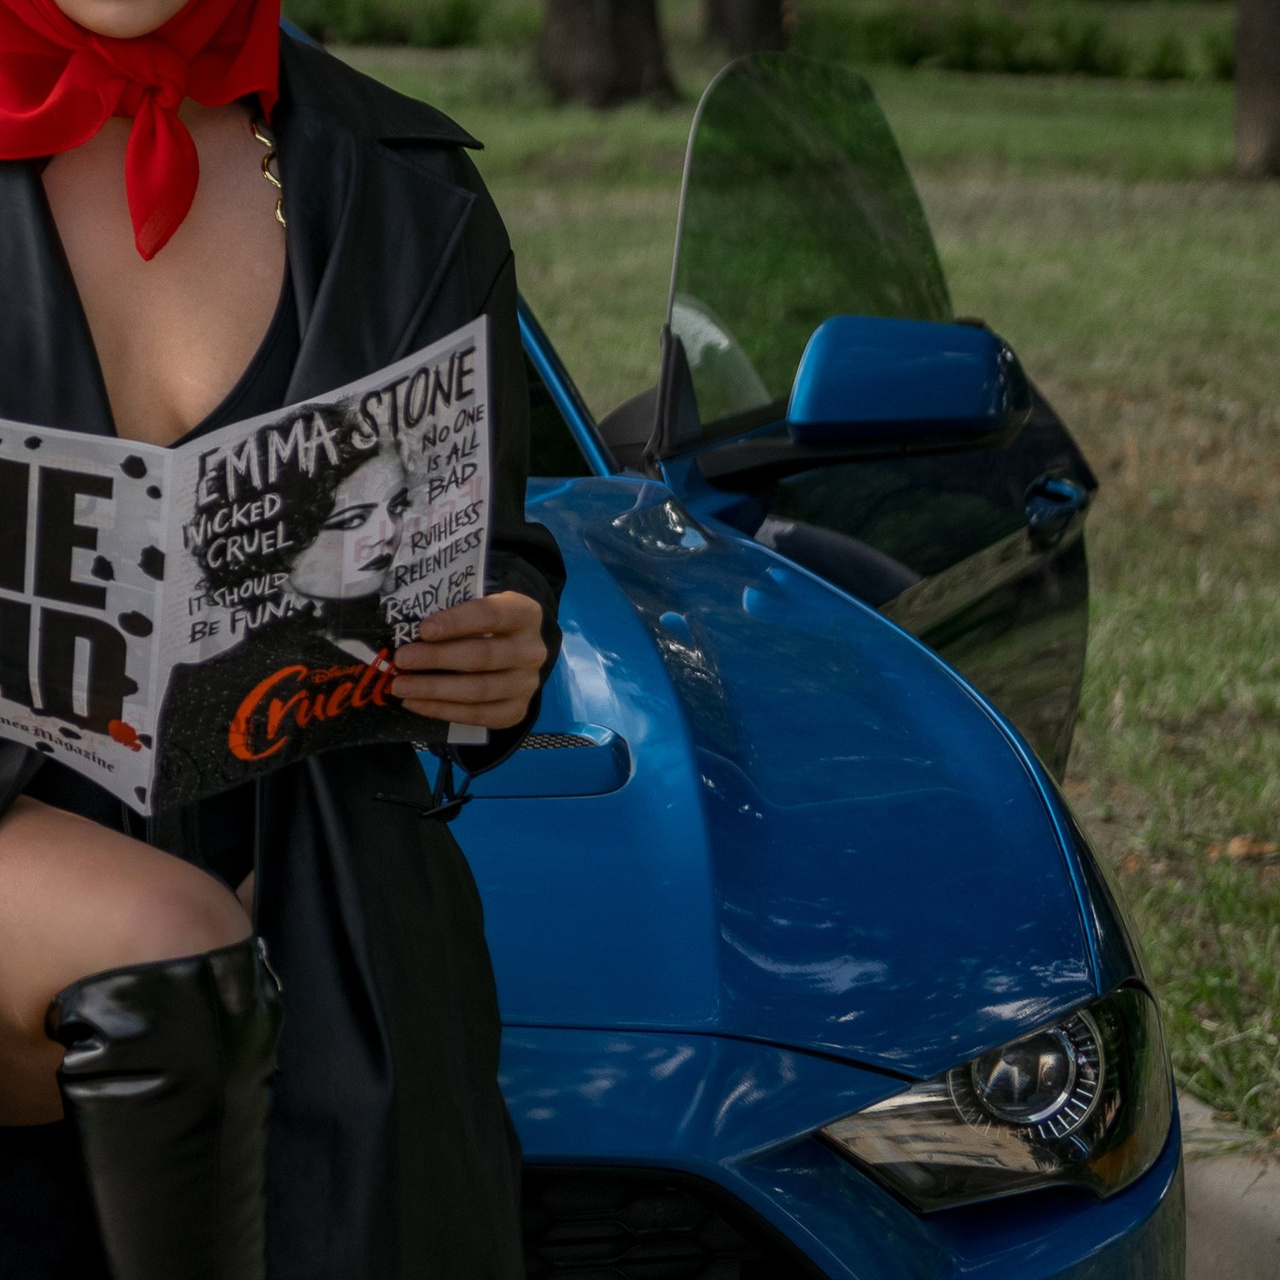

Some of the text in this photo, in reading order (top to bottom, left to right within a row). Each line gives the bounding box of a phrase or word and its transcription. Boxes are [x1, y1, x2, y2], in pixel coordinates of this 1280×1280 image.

[196, 346, 476, 508] EMMA STONE
[422, 404, 484, 454] NO ONE
[427, 429, 480, 475] IS ALL
[426, 462, 478, 505] BAD
[182, 492, 281, 549] WICKED
[206, 521, 294, 568] CRUEL
[410, 499, 484, 555] RUTHLESS
[394, 527, 485, 589] RELENTLESS
[188, 572, 289, 616] IT SHOULD
[188, 592, 296, 644] BE FUN!
[385, 565, 476, 624] READY FOR
[228, 646, 396, 761] Cruell
[27, 727, 115, 773] Magazine
